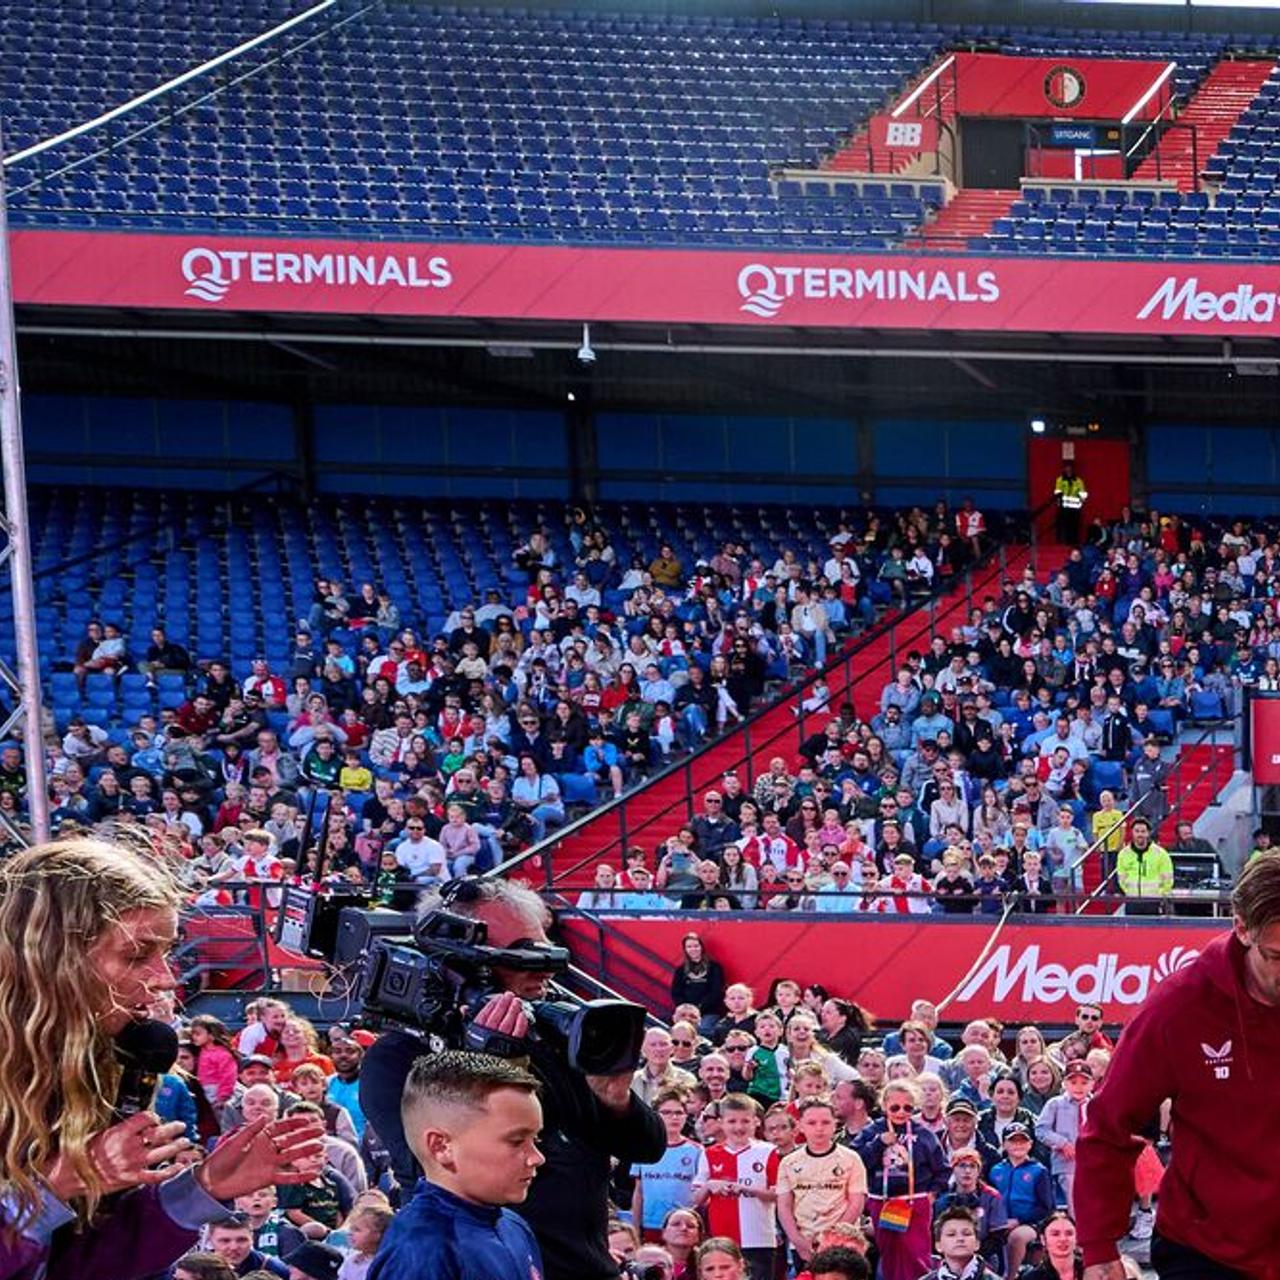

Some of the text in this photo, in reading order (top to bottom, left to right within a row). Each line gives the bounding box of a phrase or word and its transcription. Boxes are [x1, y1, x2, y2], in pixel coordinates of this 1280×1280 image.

[181, 247, 452, 302] QTERMINALS
[737, 263, 1000, 318] QTERMINALS
[956, 945, 1152, 1005] Media
[1214, 1066, 1230, 1079] 10
